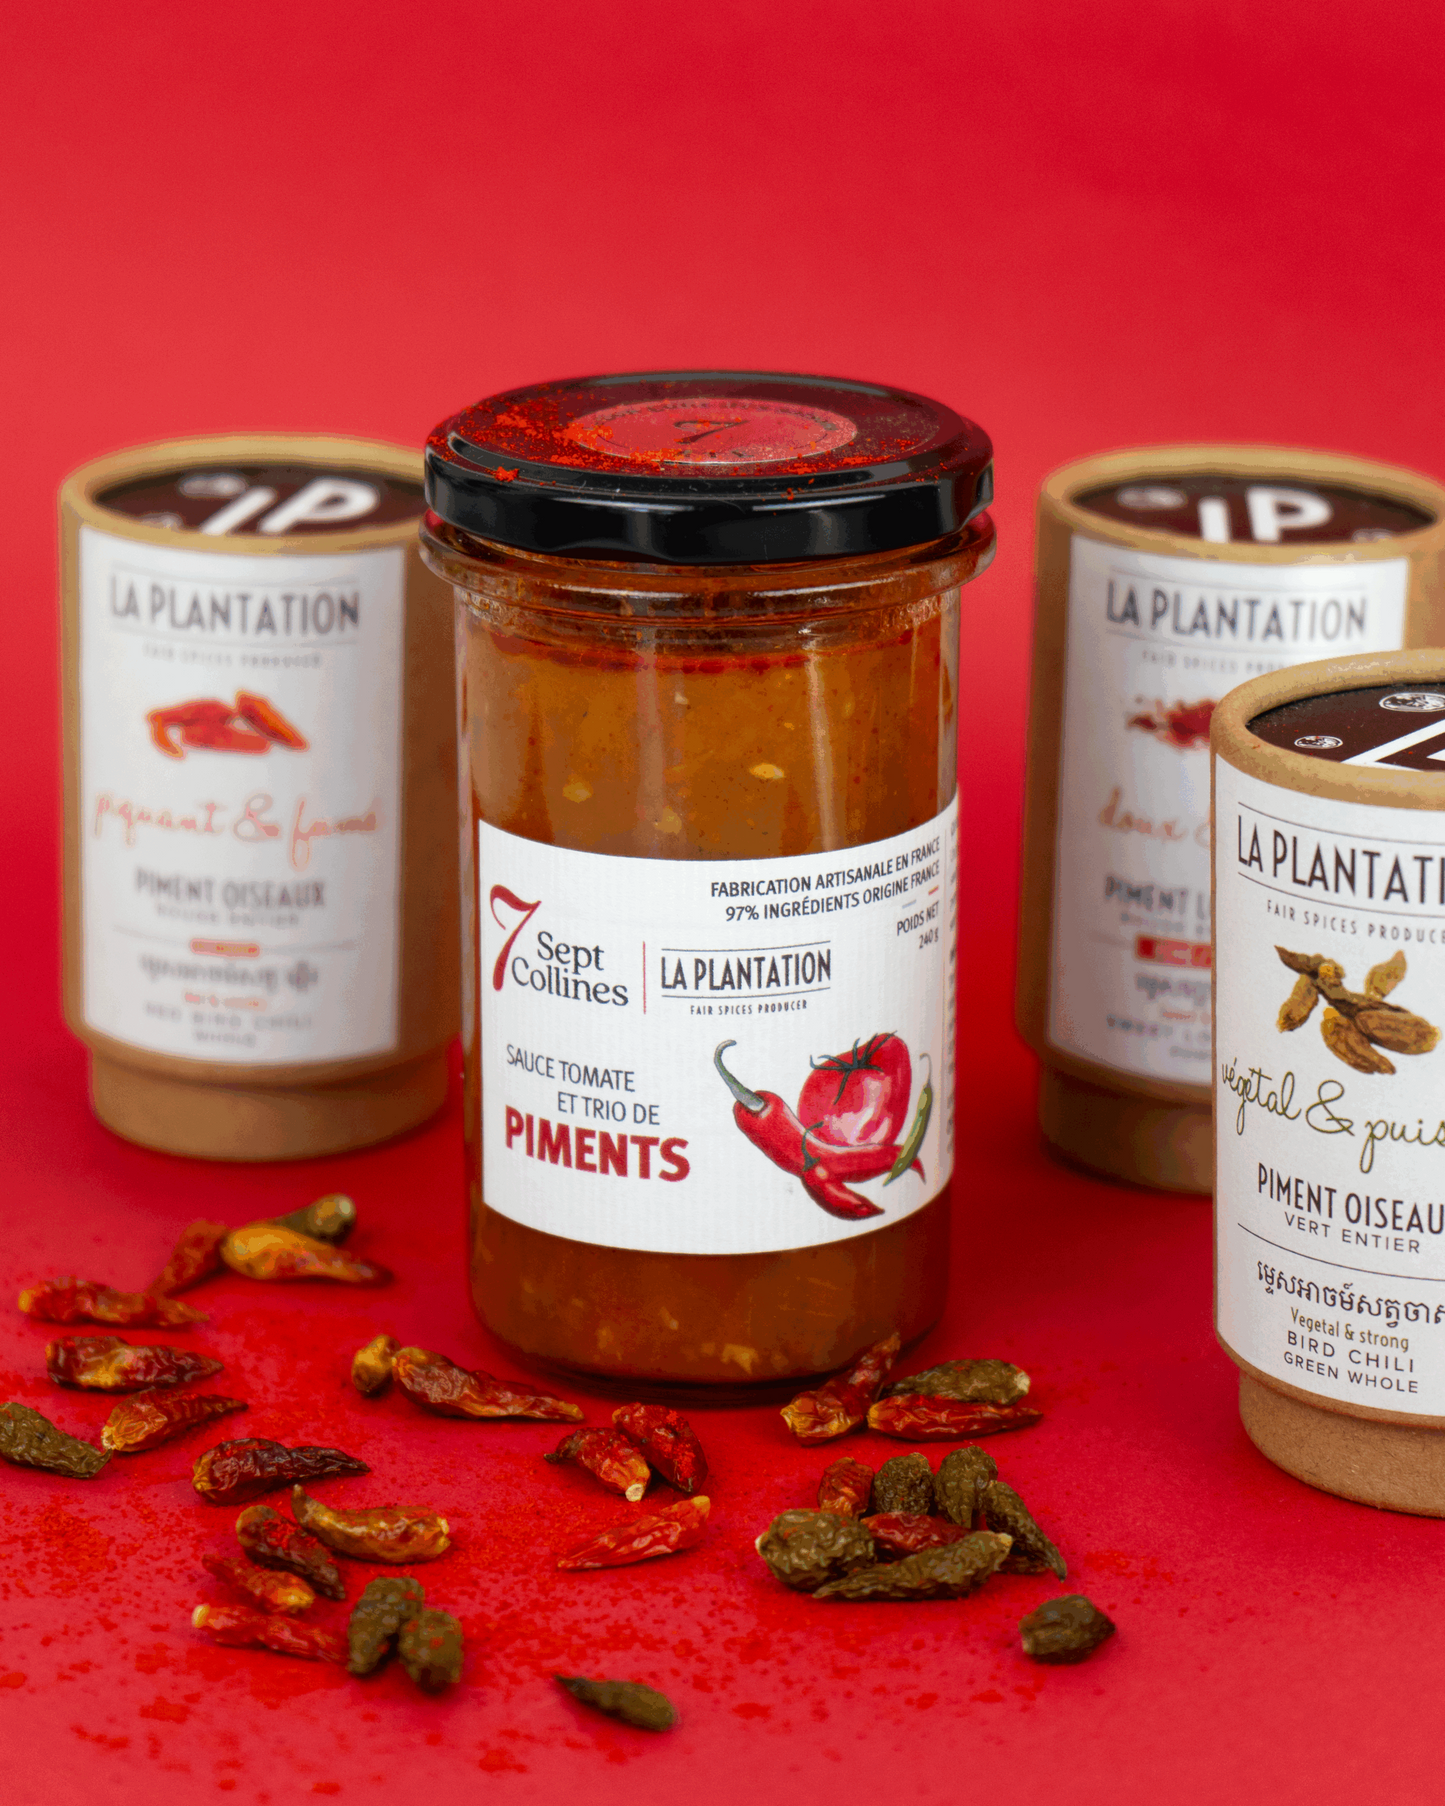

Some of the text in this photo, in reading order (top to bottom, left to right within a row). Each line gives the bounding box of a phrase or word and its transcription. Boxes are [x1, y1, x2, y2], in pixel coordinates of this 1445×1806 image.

[110, 574, 360, 636] LA PLANTATION
[1106, 578, 1367, 642] LA PLANTATION
[710, 836, 940, 898] FABRICATION ARTISANALE EN FRANCE
[1238, 815, 1263, 872] LA
[726, 859, 940, 922] 97% INGRÉDIENTS ORIGINE FRANCE
[490, 884, 542, 992] 7
[897, 900, 939, 936] POIDS NET
[919, 927, 939, 949] 240 g
[1267, 900, 1295, 921] FAIR
[1304, 911, 1357, 935] SPICES
[537, 931, 605, 975] Sept
[661, 948, 831, 990] LA PLANTATION
[511, 956, 629, 1006] Collines
[690, 999, 807, 1015] FAIR SPICES PRODUCER
[506, 1044, 635, 1092] SAUCE TOMATE
[557, 1091, 660, 1125] ET TRIO DE
[1221, 1056, 1302, 1136] végétal
[1305, 1079, 1355, 1136] &
[505, 1104, 691, 1182] PIMENTS
[1258, 1162, 1444, 1234] PIMENT OISEAU
[1284, 1211, 1420, 1254] VERT ENTIER
[1287, 1330, 1414, 1373] BIRD CHILI
[1290, 1306, 1409, 1353] Vegetal & strong
[1284, 1351, 1419, 1393] GREEN WHOLE
